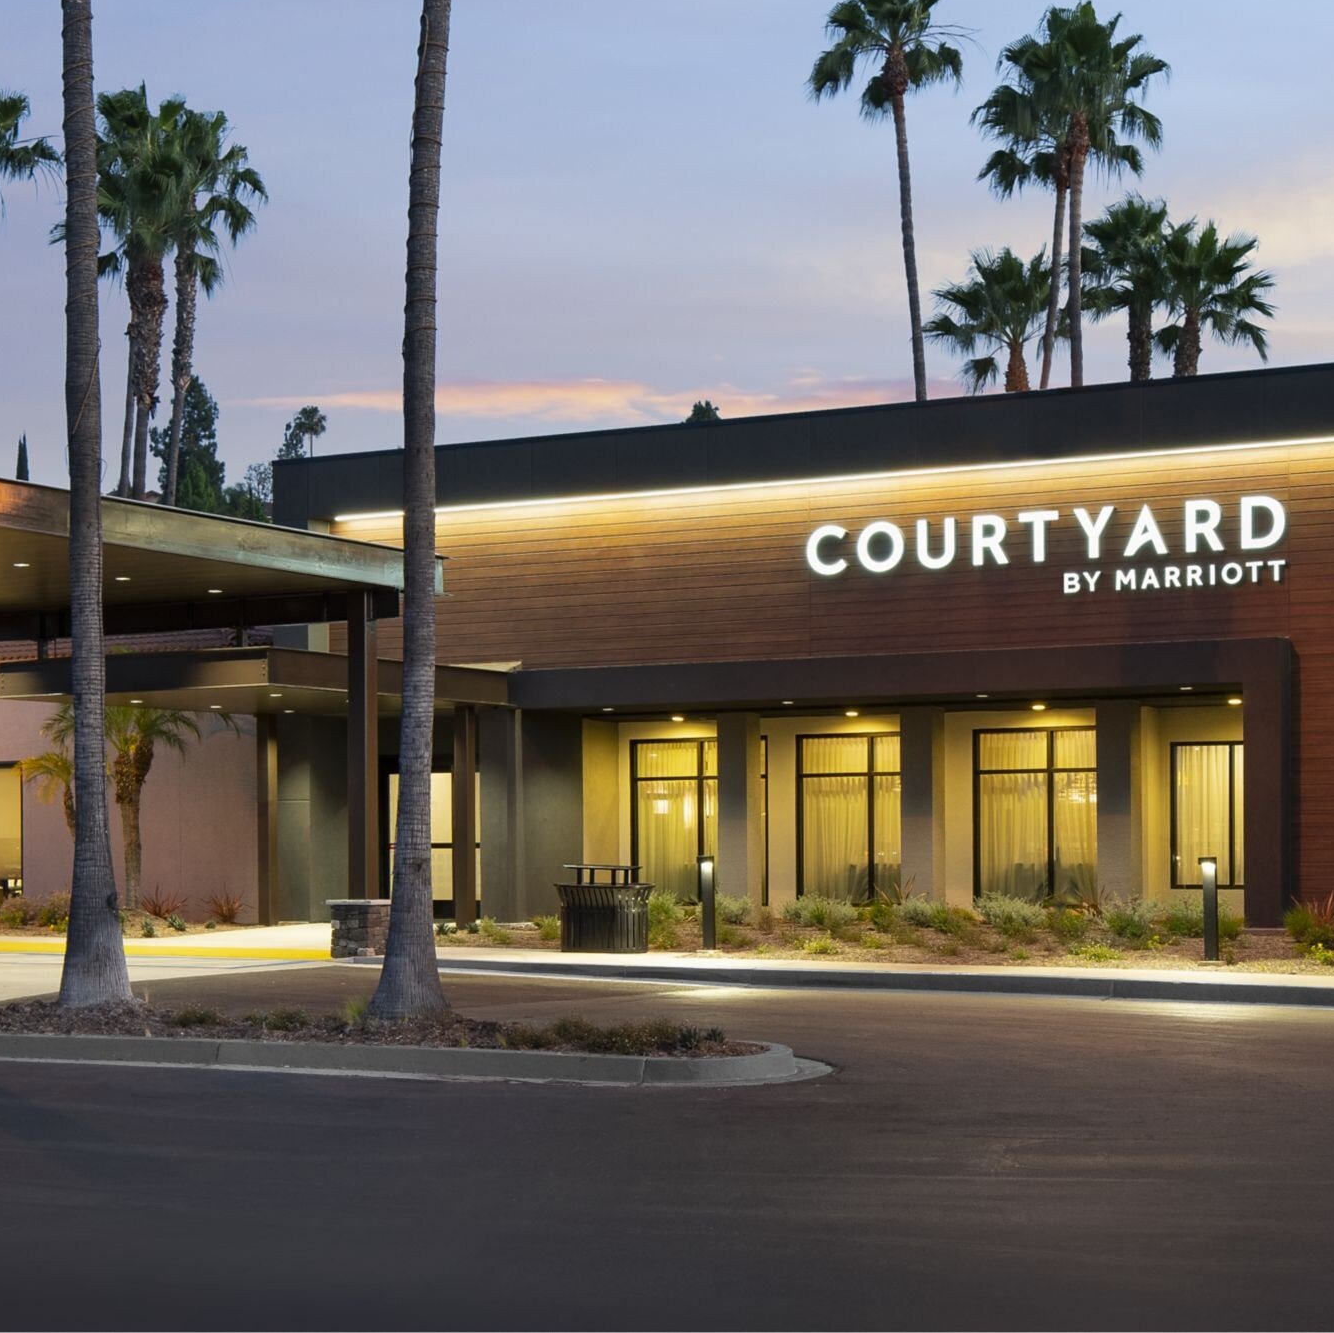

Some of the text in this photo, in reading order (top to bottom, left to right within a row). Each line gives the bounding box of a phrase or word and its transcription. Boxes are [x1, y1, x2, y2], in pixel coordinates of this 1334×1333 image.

[805, 495, 1287, 576] COURTYARD
[1063, 559, 1287, 594] BY MARRIOTT
